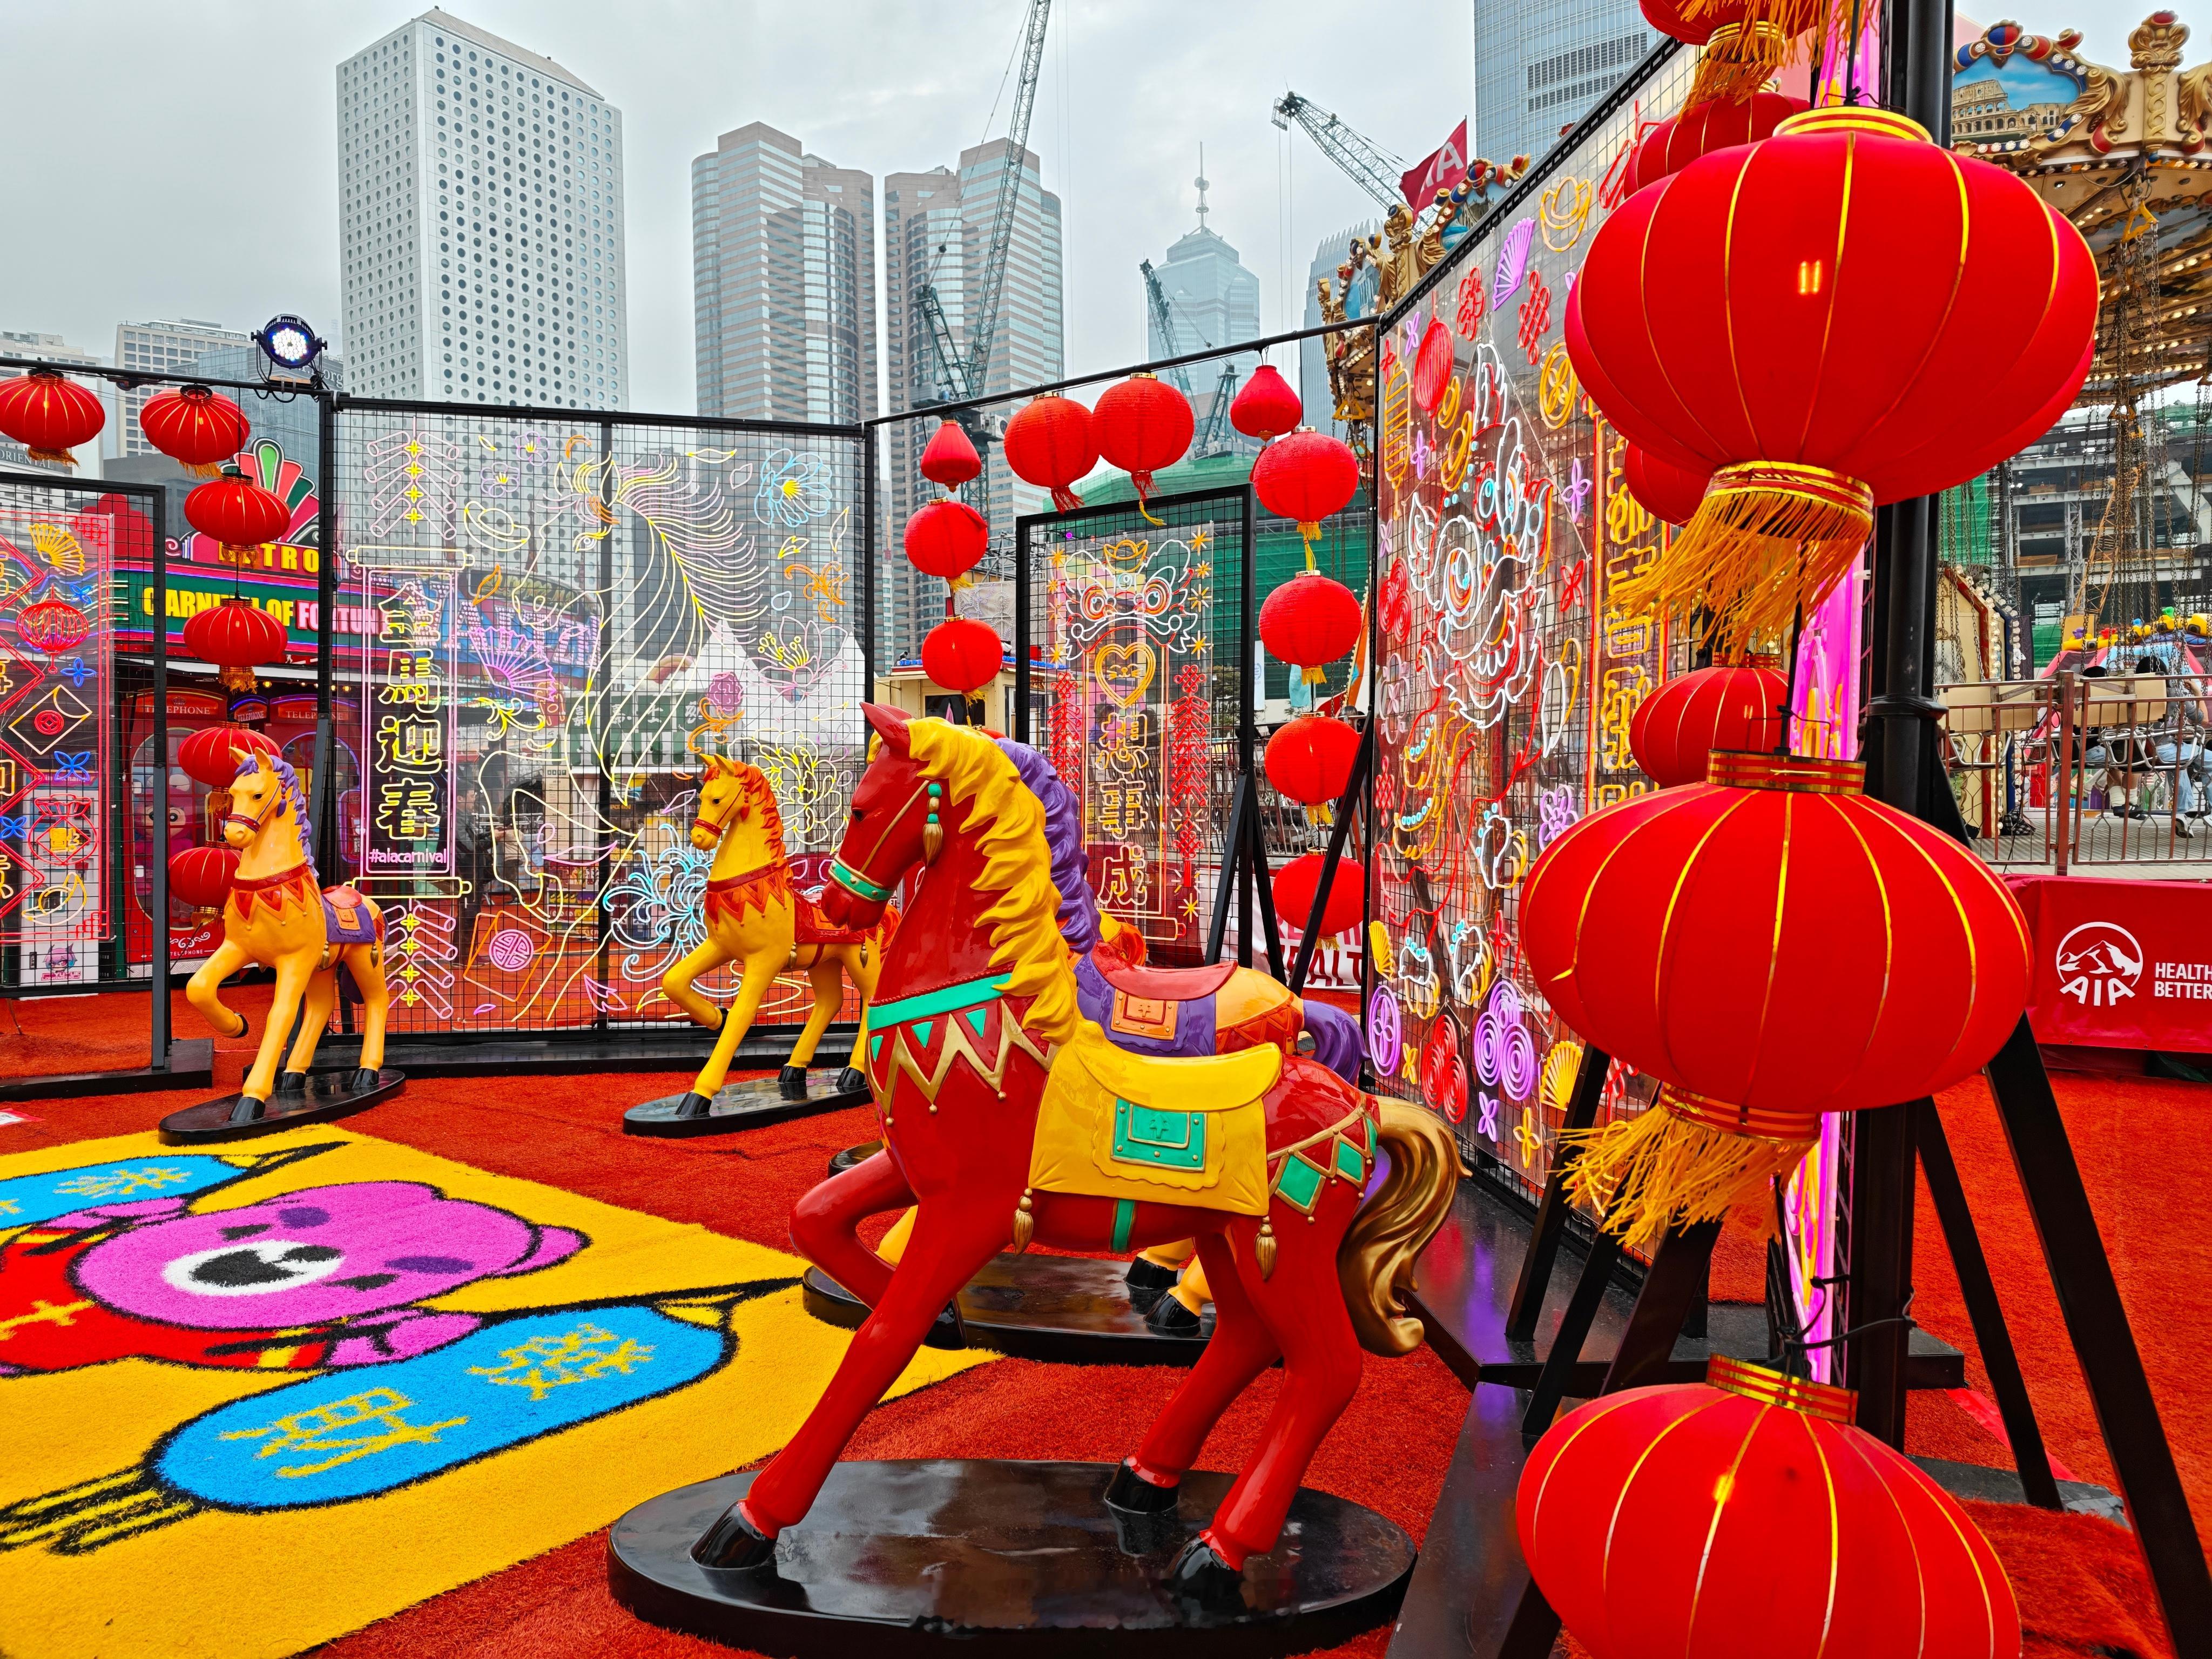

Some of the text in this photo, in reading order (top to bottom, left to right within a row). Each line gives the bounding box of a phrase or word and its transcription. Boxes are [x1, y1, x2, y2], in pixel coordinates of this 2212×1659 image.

[266, 598, 294, 626] OF
[144, 705, 210, 714] TEPHONE
[238, 711, 264, 722] TELEPHONE
[286, 711, 345, 720] TELEPNE
[376, 582, 442, 840] 金馬迎春
[369, 848, 447, 863] #aiacarnival
[2059, 975, 2136, 1007] AIA
[2154, 980, 2212, 1000] BETTER
